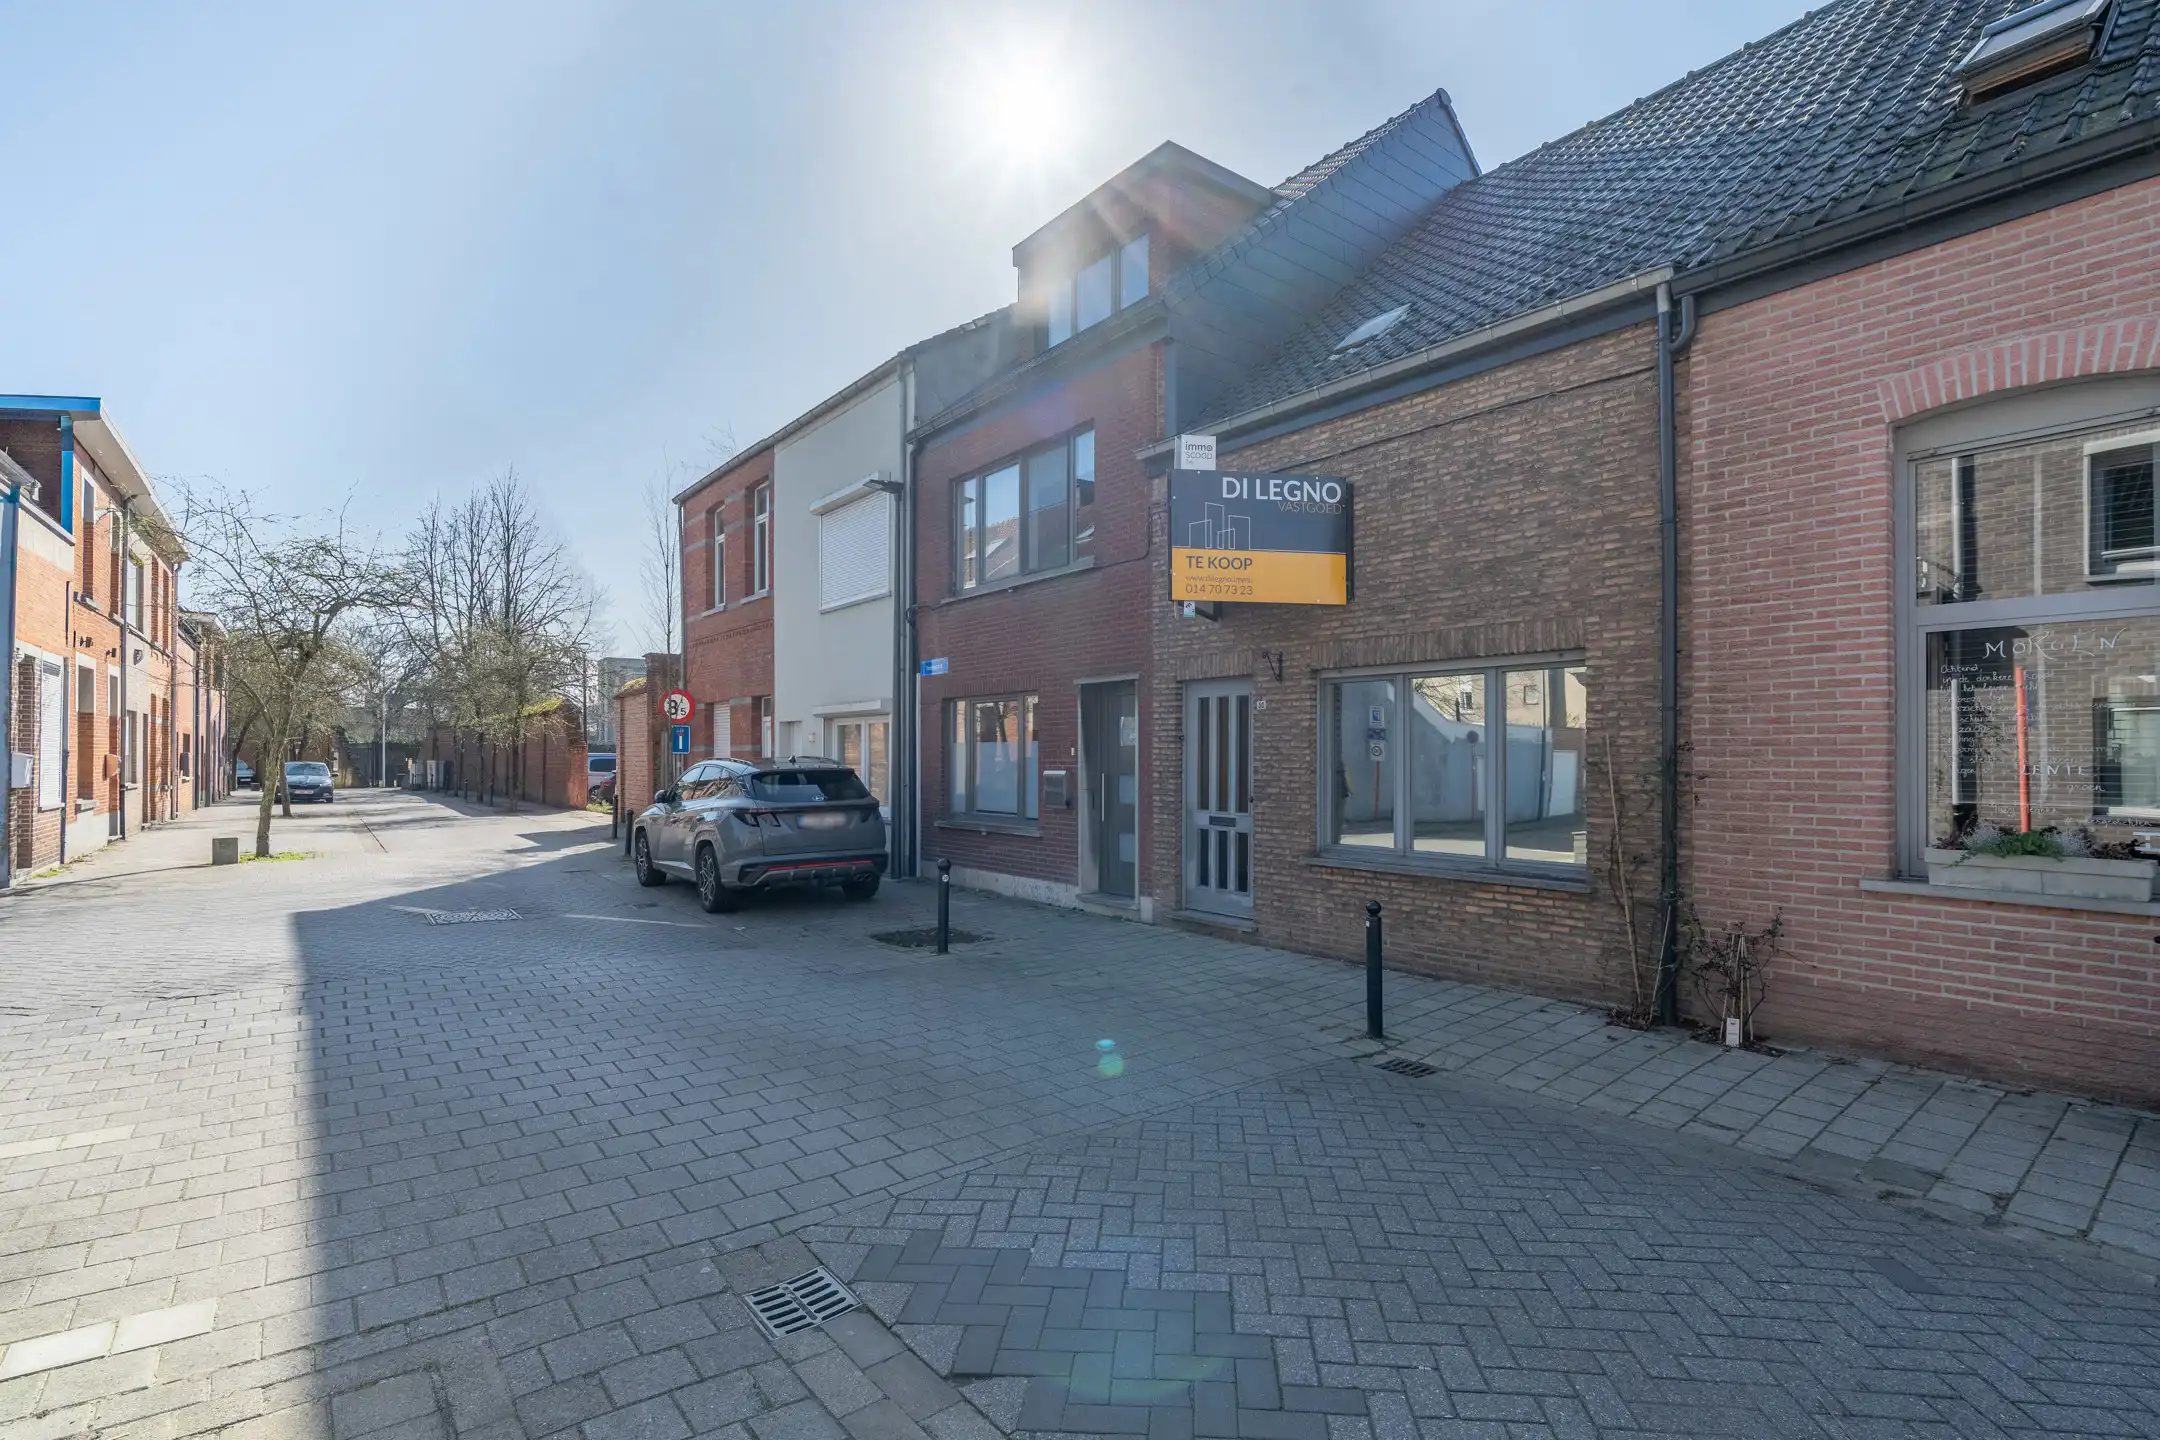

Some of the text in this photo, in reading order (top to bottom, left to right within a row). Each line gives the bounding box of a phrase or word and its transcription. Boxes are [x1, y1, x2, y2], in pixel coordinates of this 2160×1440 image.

[1185, 441, 1213, 452] immo
[1185, 451, 1213, 460] scoop
[1222, 477, 1342, 503] DI LEGNO
[1277, 501, 1342, 514] VASTGOED
[1185, 555, 1253, 570] TE KOOP
[1185, 583, 1253, 595] 014 70 73 23
[1983, 627, 2127, 661] MORGEN
[1976, 671, 2013, 682] donkere
